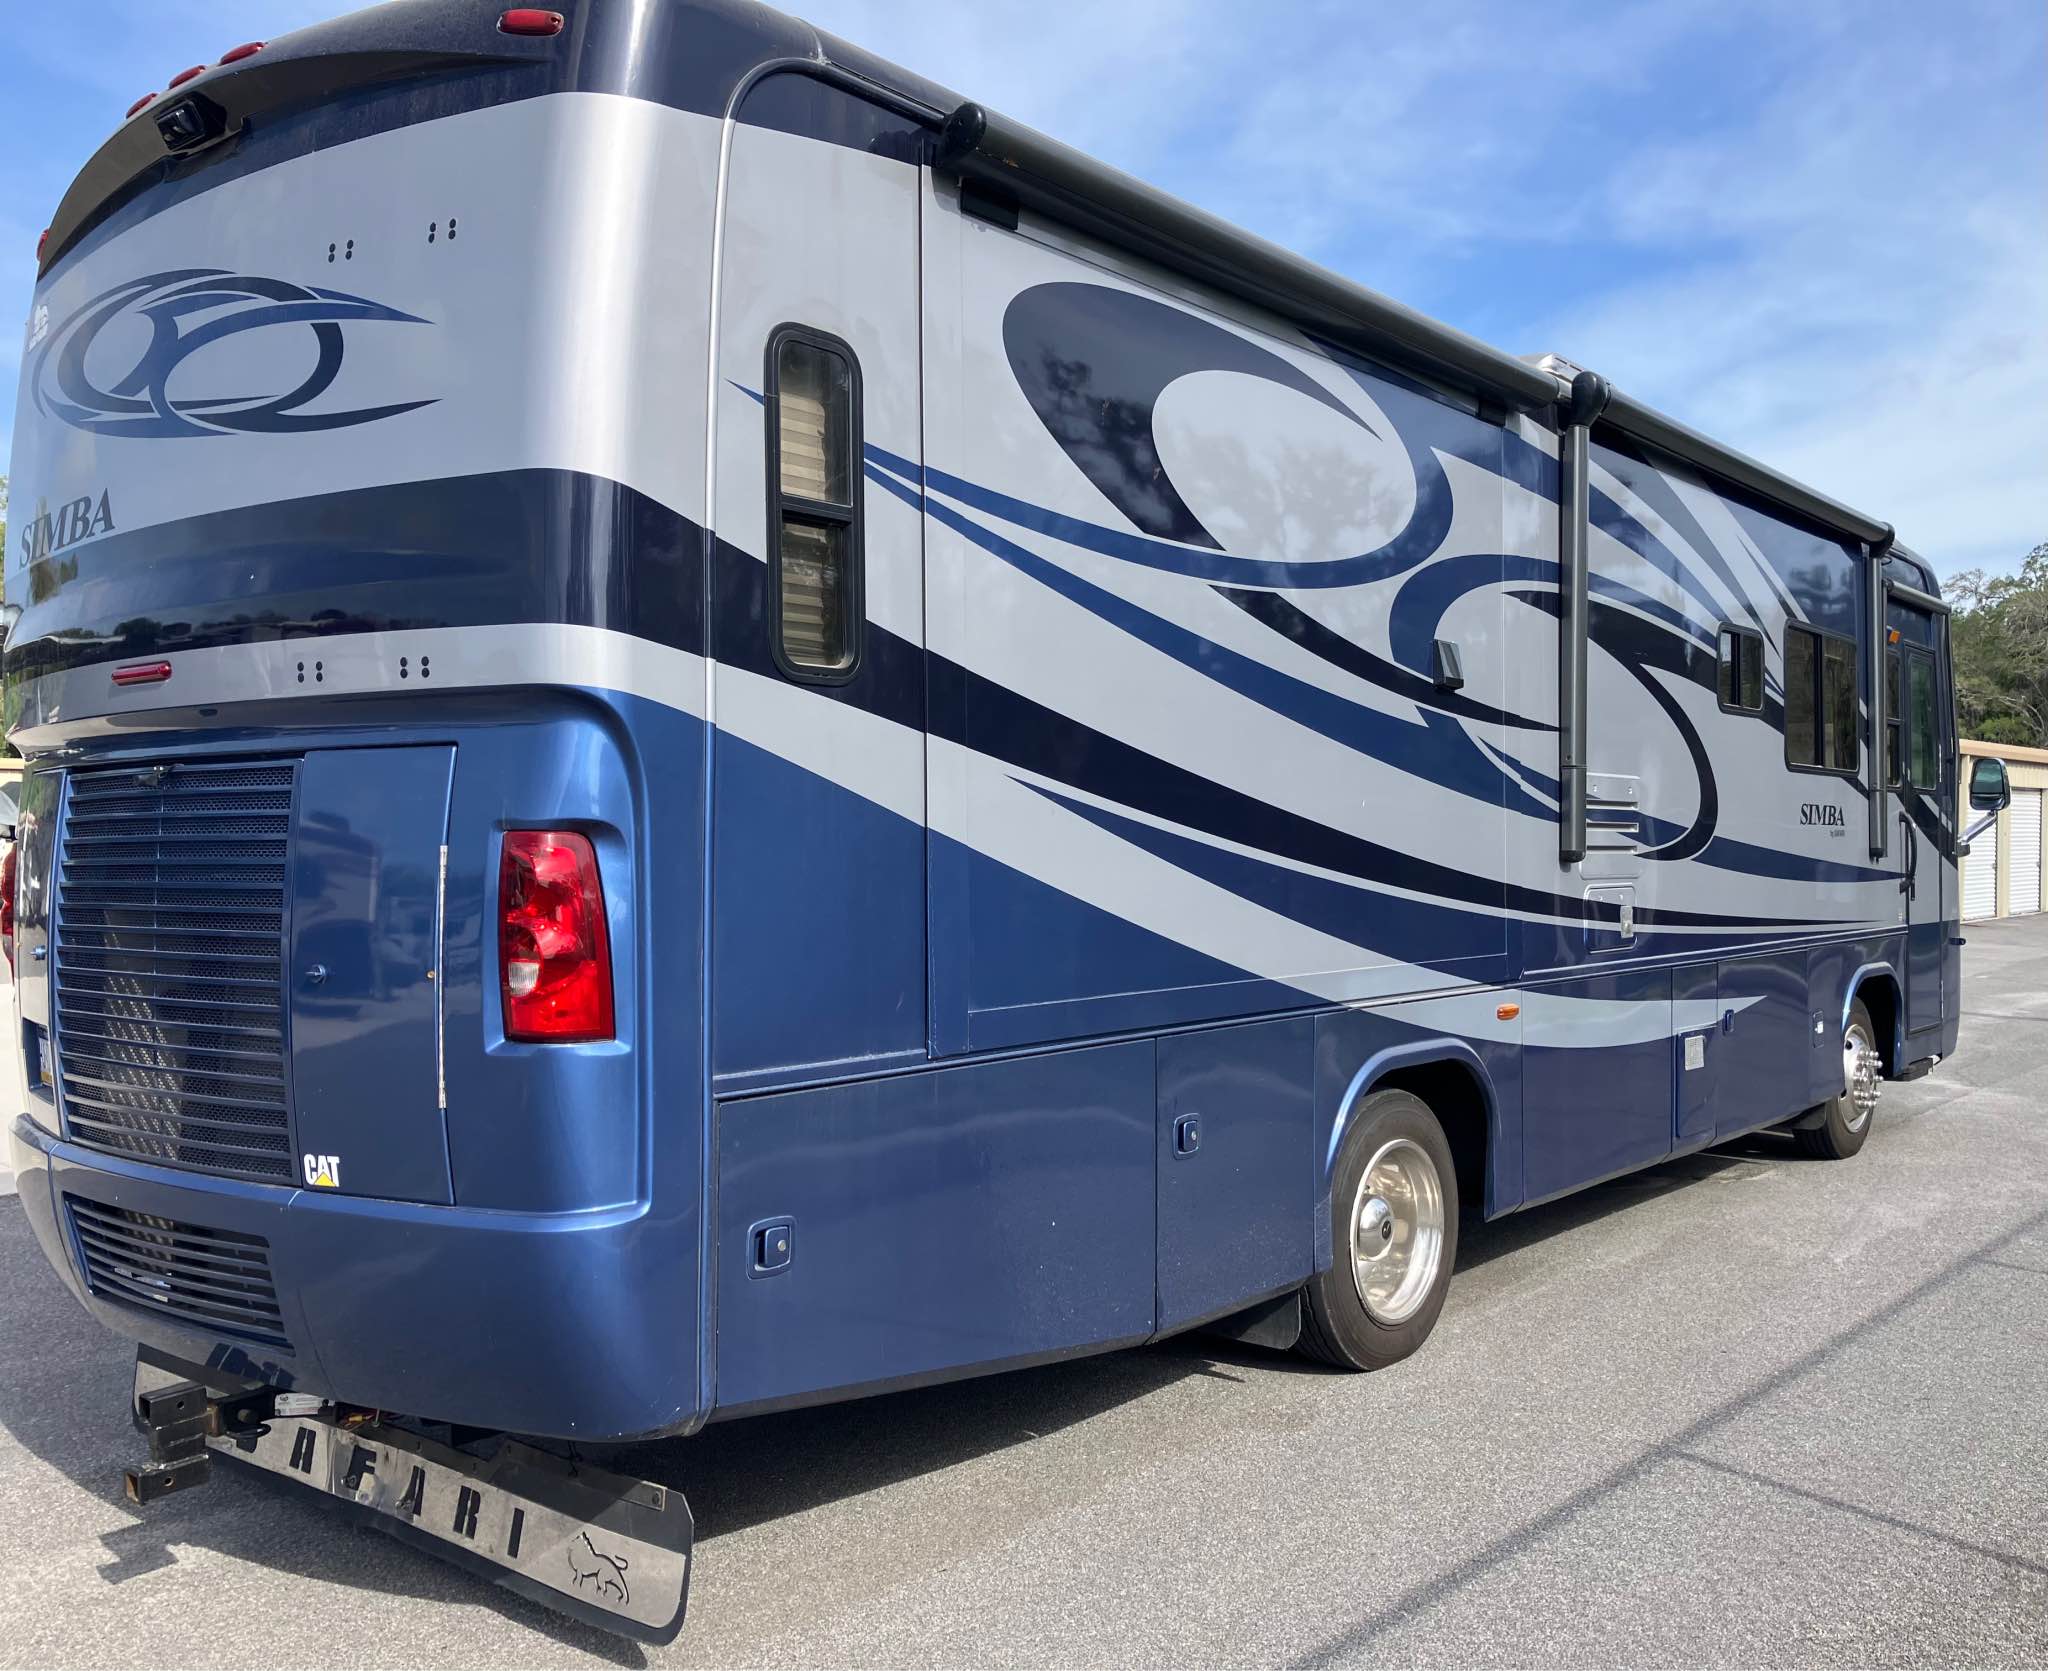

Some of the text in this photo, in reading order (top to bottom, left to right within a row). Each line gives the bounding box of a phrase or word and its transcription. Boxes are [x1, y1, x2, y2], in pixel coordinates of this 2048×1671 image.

[19, 487, 116, 569] SIMBA
[1800, 803, 1845, 826] SIMBA
[303, 1153, 340, 1187] CAT
